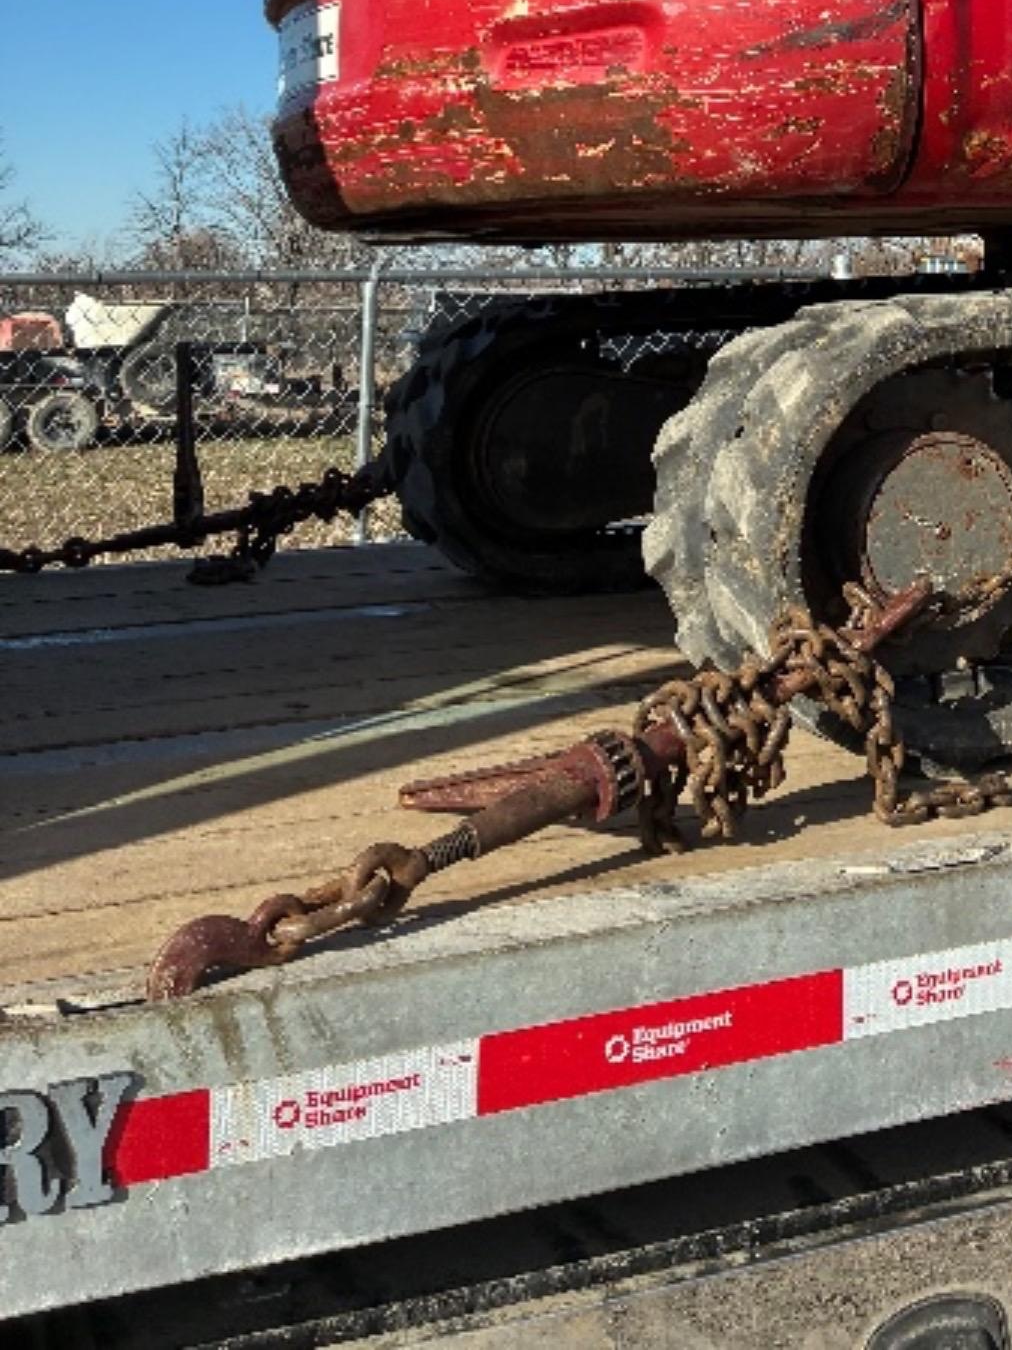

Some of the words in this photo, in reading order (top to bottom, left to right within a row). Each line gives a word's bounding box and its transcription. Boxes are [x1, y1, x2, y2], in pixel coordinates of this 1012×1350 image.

[632, 1010, 733, 1045] Equipment
[632, 1039, 690, 1063] Share
[305, 1073, 422, 1108] Equipment
[304, 1105, 368, 1129] Share
